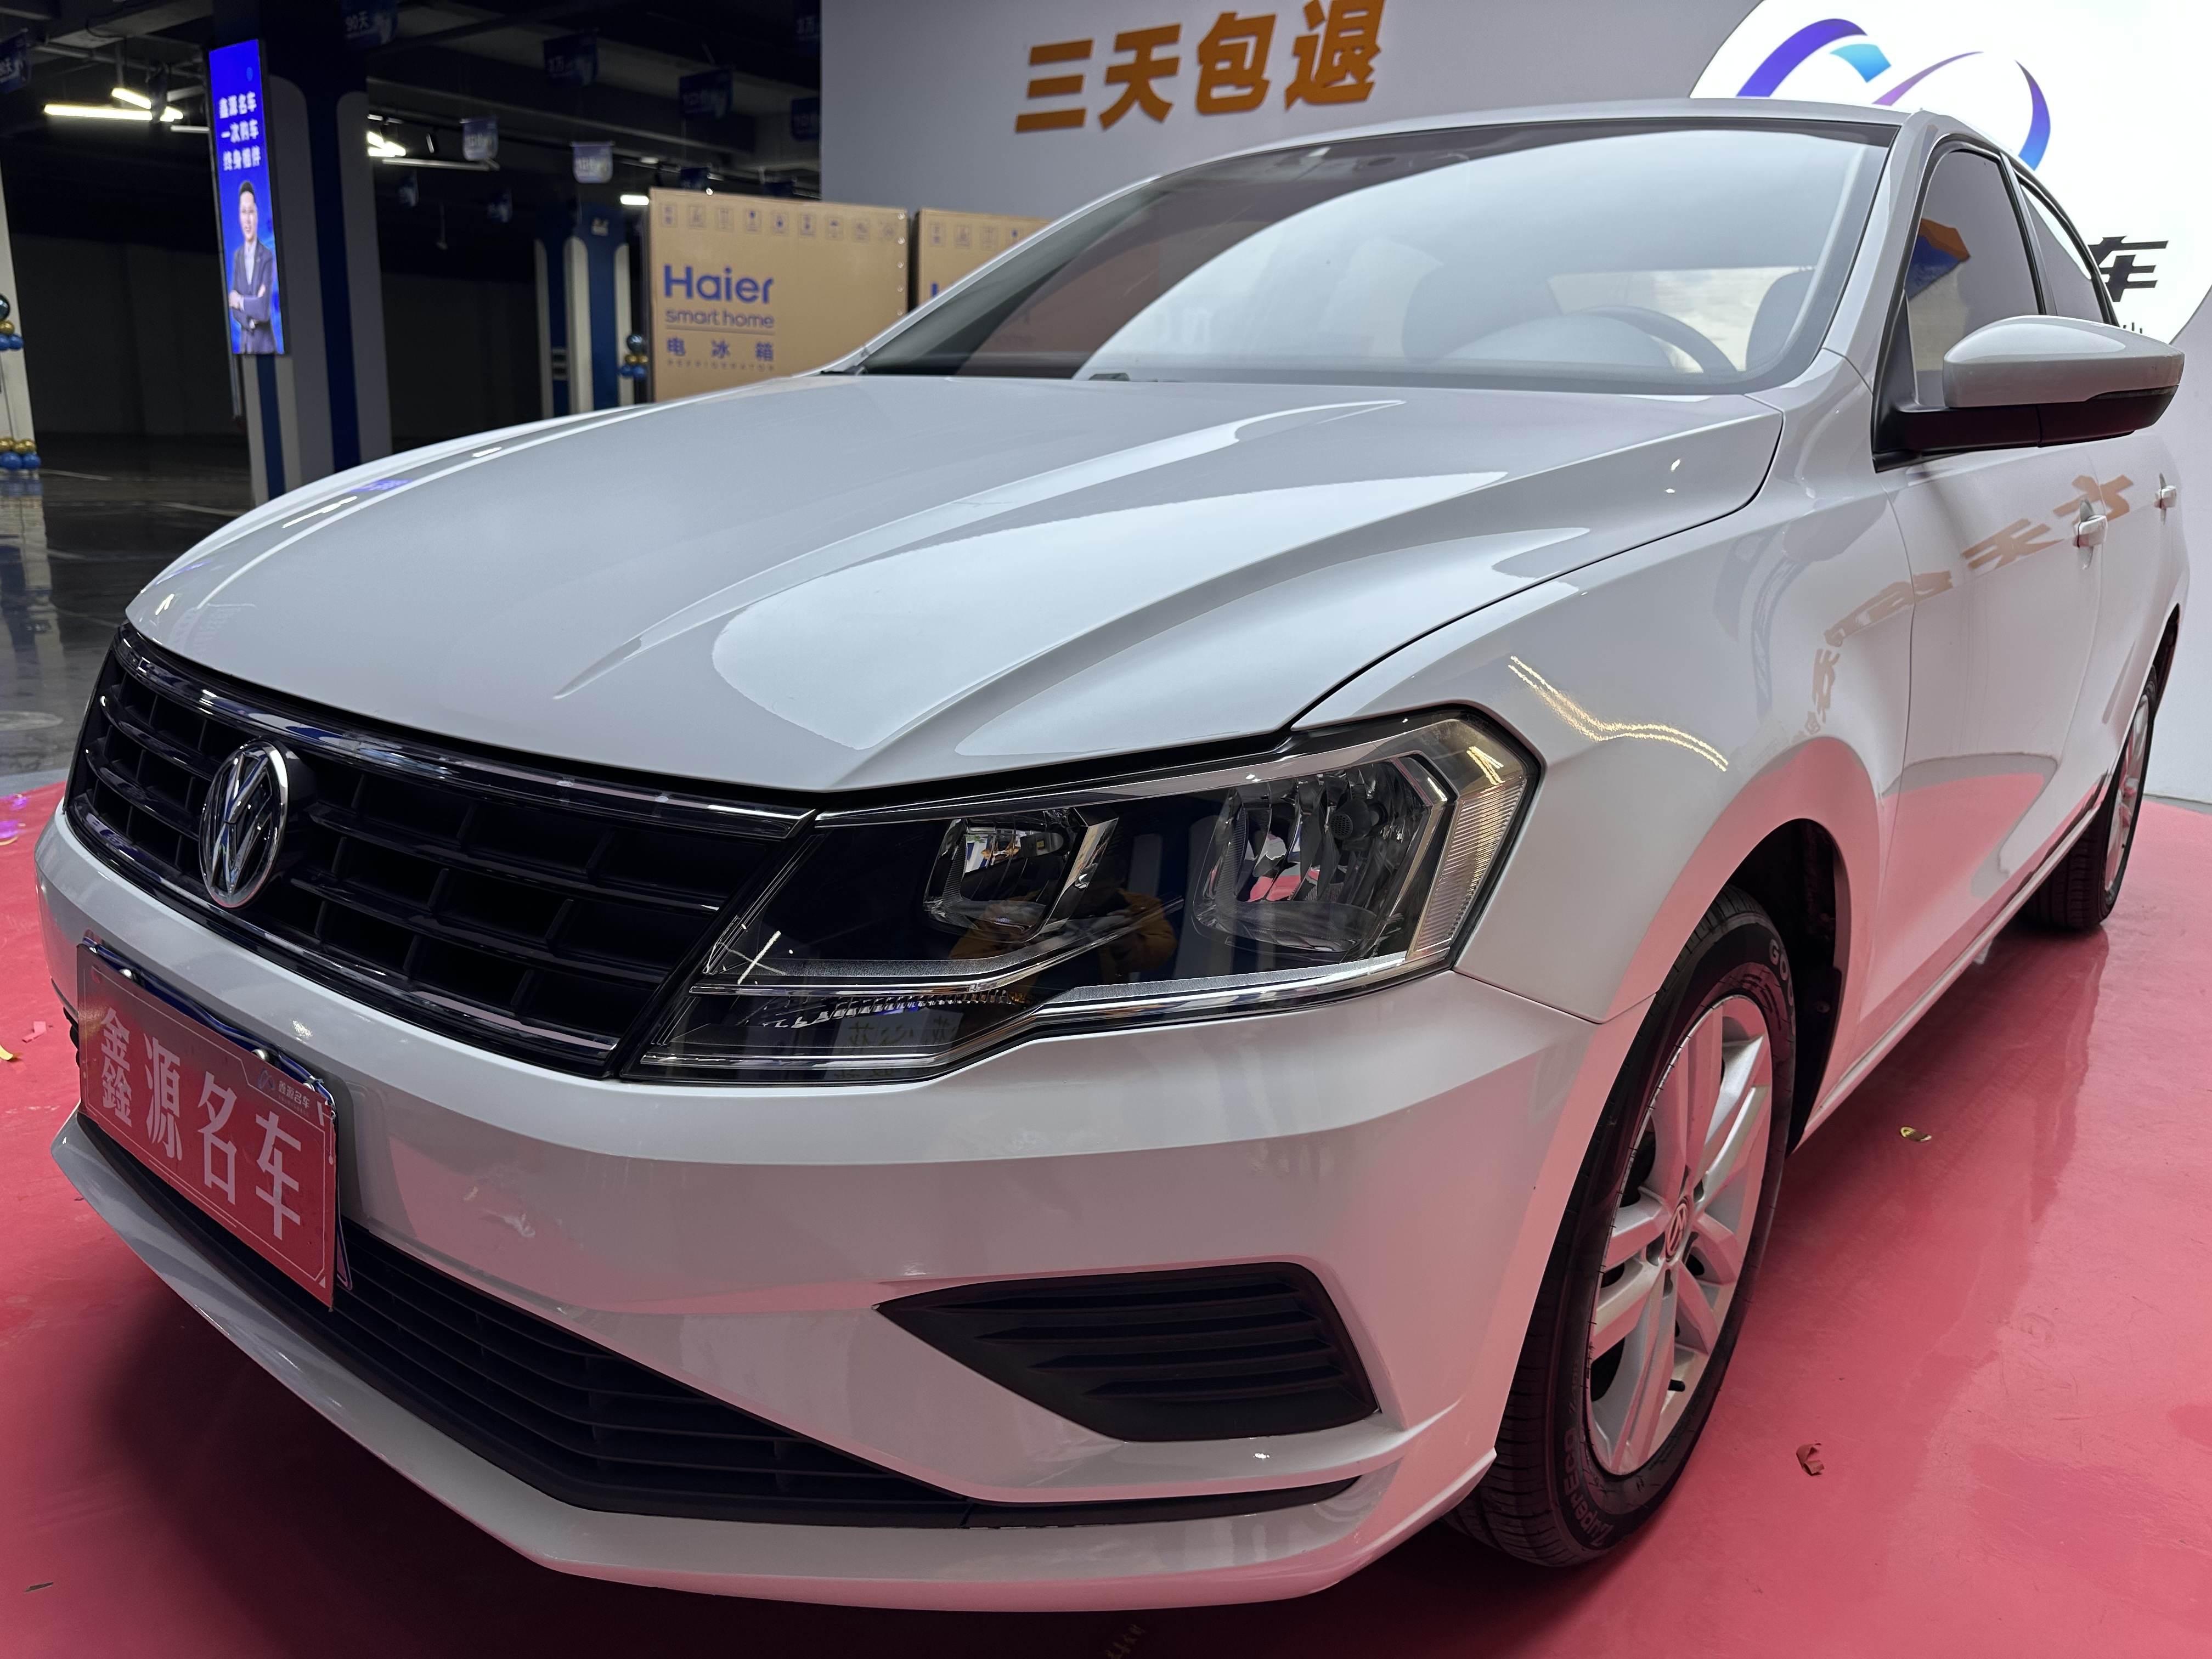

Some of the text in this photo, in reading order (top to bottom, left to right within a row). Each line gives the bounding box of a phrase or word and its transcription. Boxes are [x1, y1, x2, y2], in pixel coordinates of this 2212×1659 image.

[1015, 0, 1385, 133] 三天包退
[664, 264, 774, 304] Haier
[665, 309, 775, 329] smart home
[667, 336, 774, 361] 电冰箱
[100, 1007, 302, 1241] 鑫源名车
